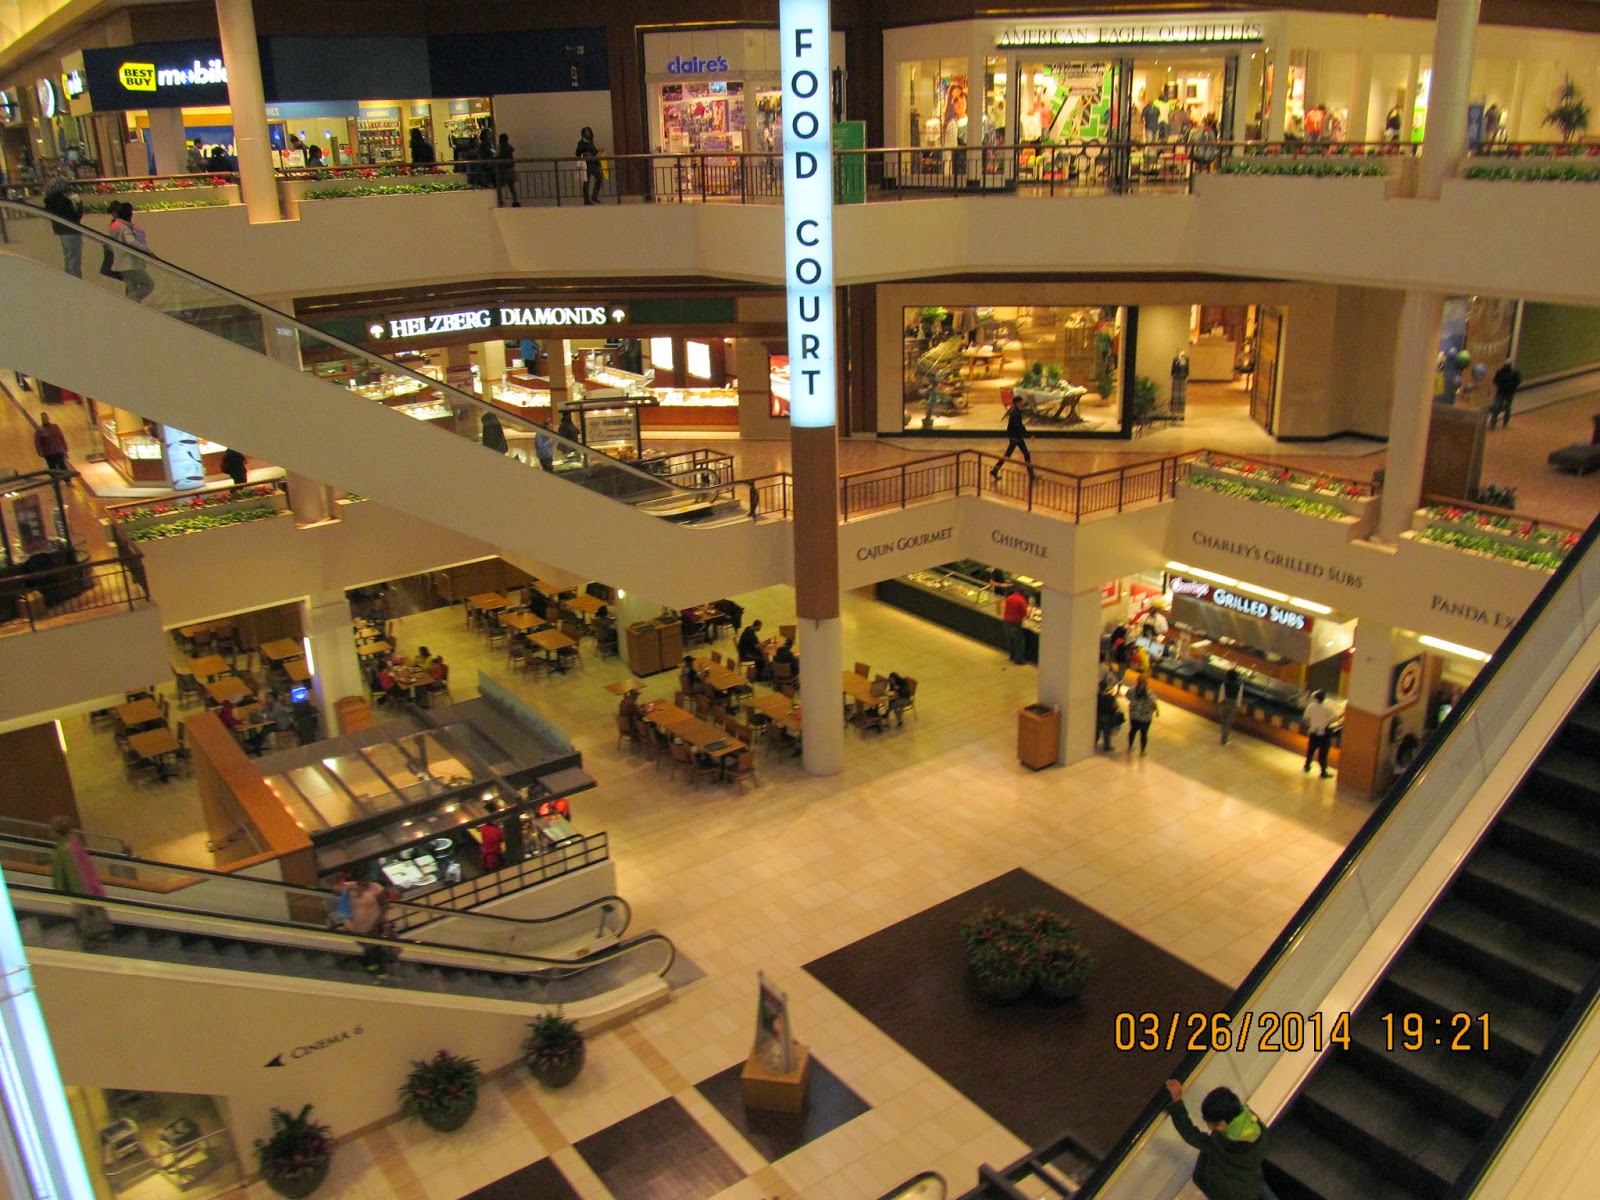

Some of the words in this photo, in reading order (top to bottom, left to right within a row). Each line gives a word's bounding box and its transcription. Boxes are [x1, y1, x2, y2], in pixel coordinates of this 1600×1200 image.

[1001, 27, 1088, 45] AMERICAN
[1099, 26, 1150, 44] EAGLE
[124, 68, 153, 78] BEST
[667, 56, 729, 74] claire's
[126, 77, 152, 87] BUY
[791, 28, 819, 179] FOOD
[390, 309, 491, 338] HELZBERG
[499, 307, 606, 326] DIAMONDS
[796, 219, 822, 395] COURT
[856, 541, 896, 561] CAJUN
[896, 527, 954, 551] GOURMET
[991, 529, 1049, 559] CHIPOTLE
[1262, 550, 1325, 580] GRILLED
[1327, 566, 1364, 590] SUBS
[1213, 588, 1268, 619] GRILLED
[1270, 605, 1306, 631] SUBS
[1431, 595, 1489, 623] PANDA
[1494, 610, 1518, 630] EX
[353, 1024, 364, 1036] 6
